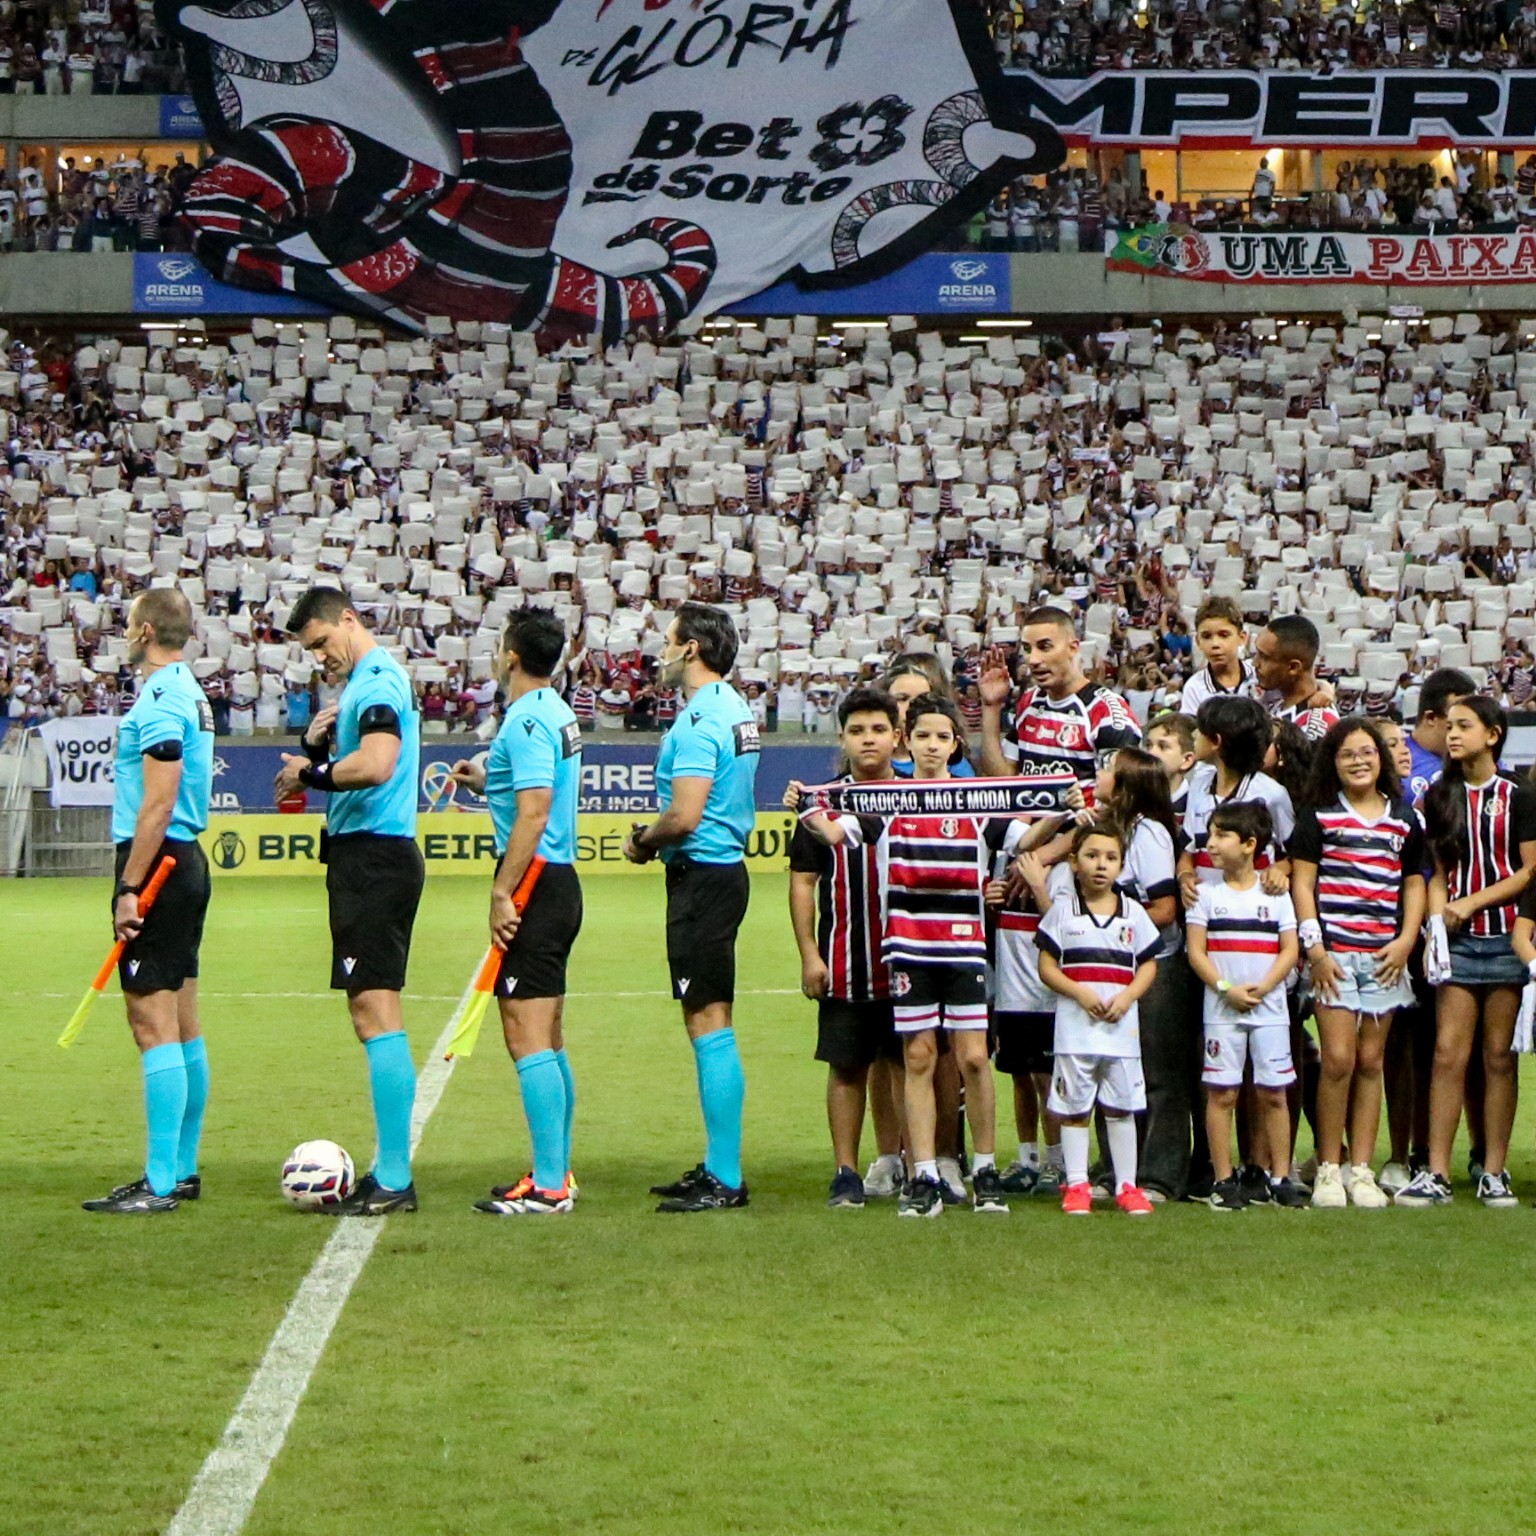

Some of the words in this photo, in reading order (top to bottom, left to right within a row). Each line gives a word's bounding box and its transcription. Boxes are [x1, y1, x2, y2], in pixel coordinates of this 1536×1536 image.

[630, 111, 803, 159] Bet
[591, 164, 661, 193] dá
[660, 164, 852, 205] Sorte
[1220, 235, 1353, 277] UMA
[145, 285, 204, 296] ARENA
[938, 285, 996, 296] ARENA
[581, 765, 655, 792] ARE
[608, 796, 662, 812] INCL
[924, 787, 953, 810] NÃO
[956, 788, 965, 809] É
[967, 788, 1011, 810] MODA!
